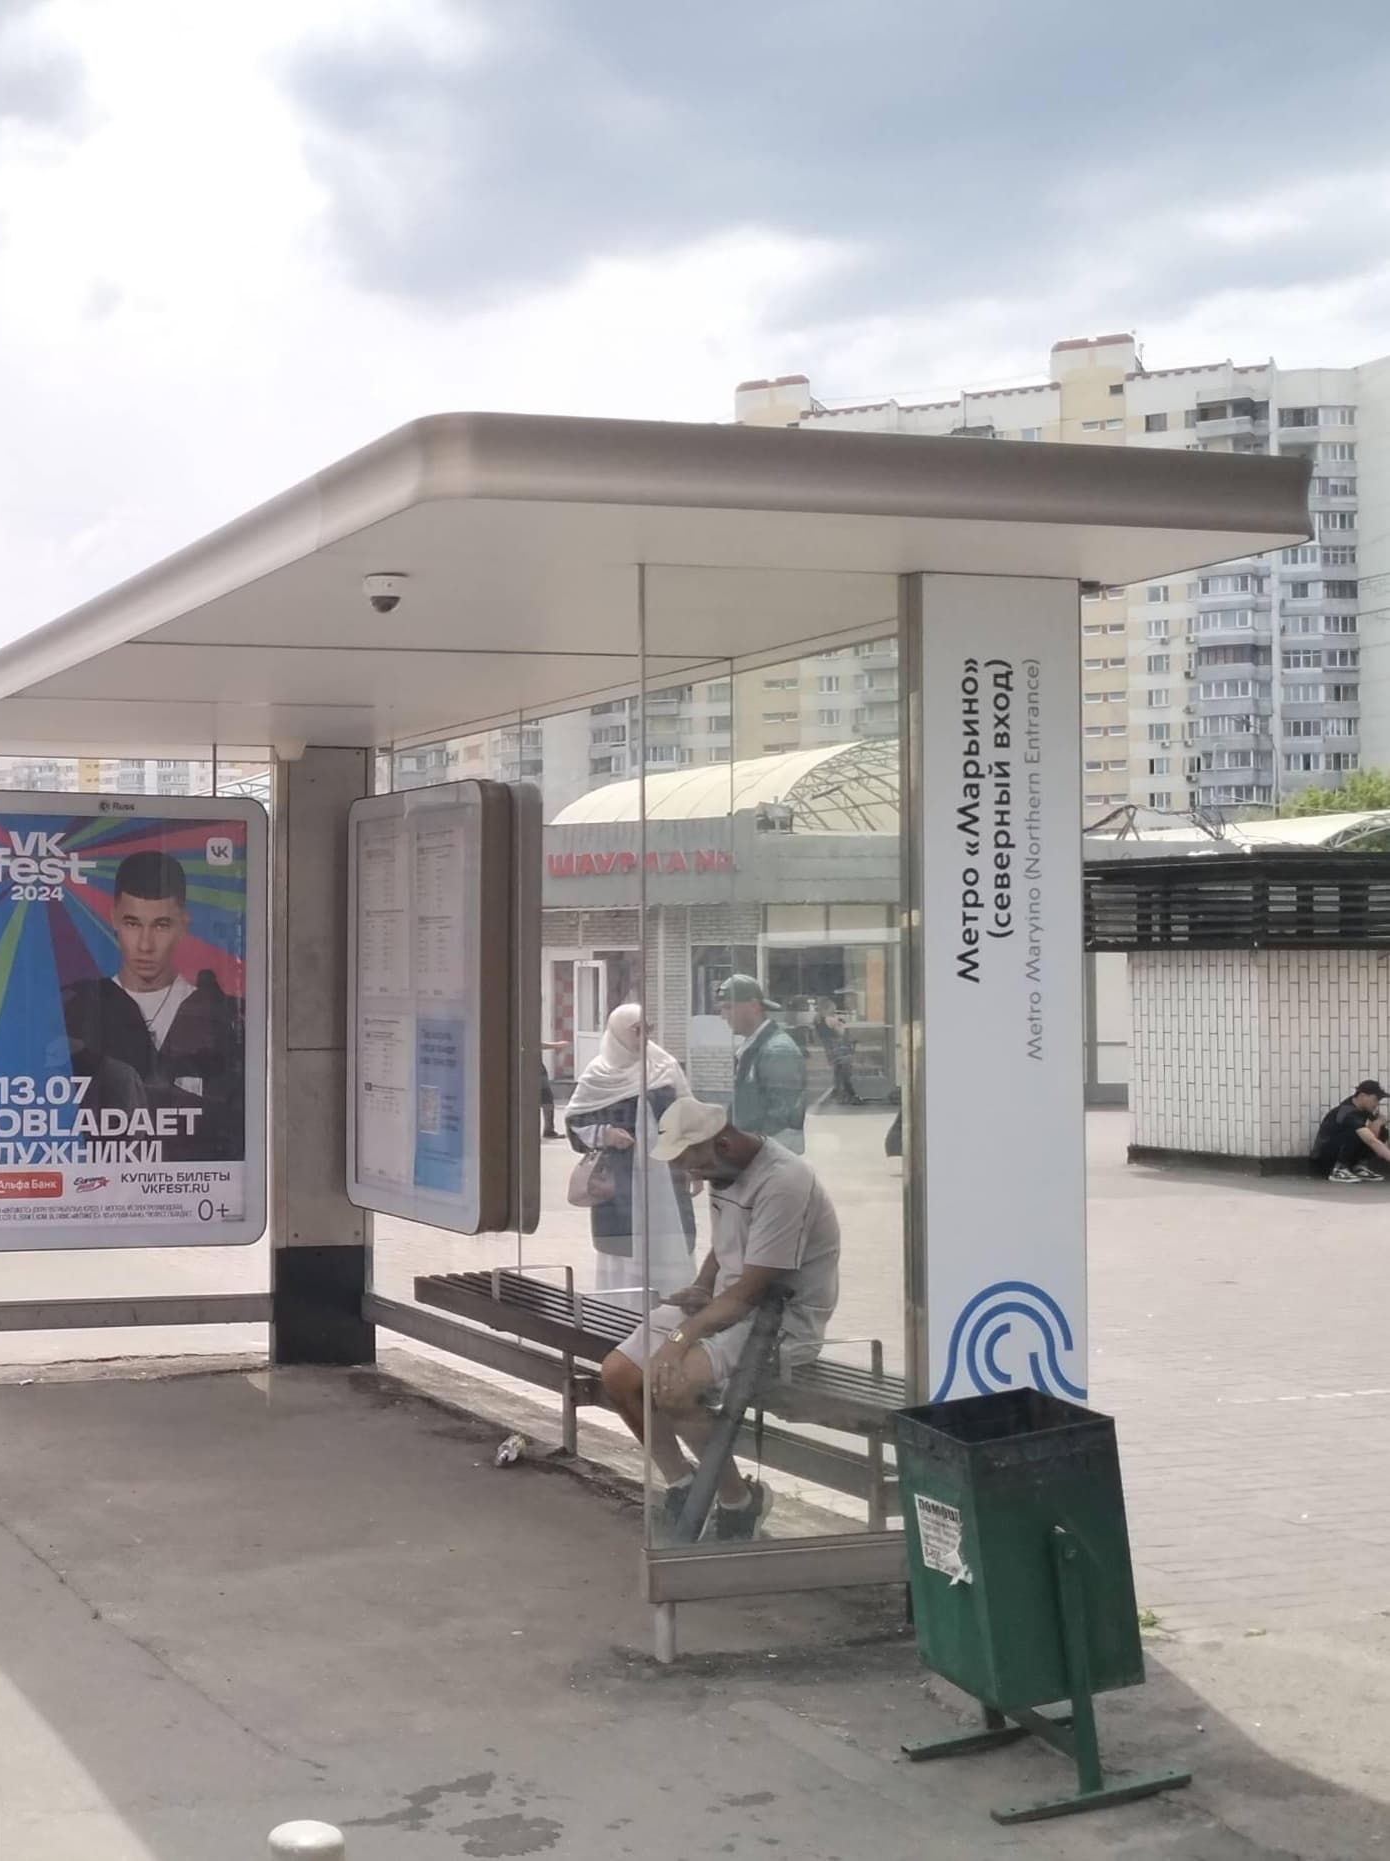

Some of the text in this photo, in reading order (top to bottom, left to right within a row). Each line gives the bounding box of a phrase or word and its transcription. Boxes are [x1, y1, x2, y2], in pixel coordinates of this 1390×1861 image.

[984, 659, 1015, 939] (северный вход)
[956, 657, 984, 984] Метро «Марьино»
[9, 831, 67, 858] VK
[211, 845, 230, 858] VK
[1023, 658, 1043, 1061] Metro Maryino (Northern Entrance)
[11, 886, 65, 901] 2024
[31, 1178, 58, 1190] Банк
[121, 1171, 231, 1184] КУПИТЬ БИЛЕТЫ
[141, 1183, 210, 1194] VKFEST.RU
[197, 1198, 230, 1222] 0+
